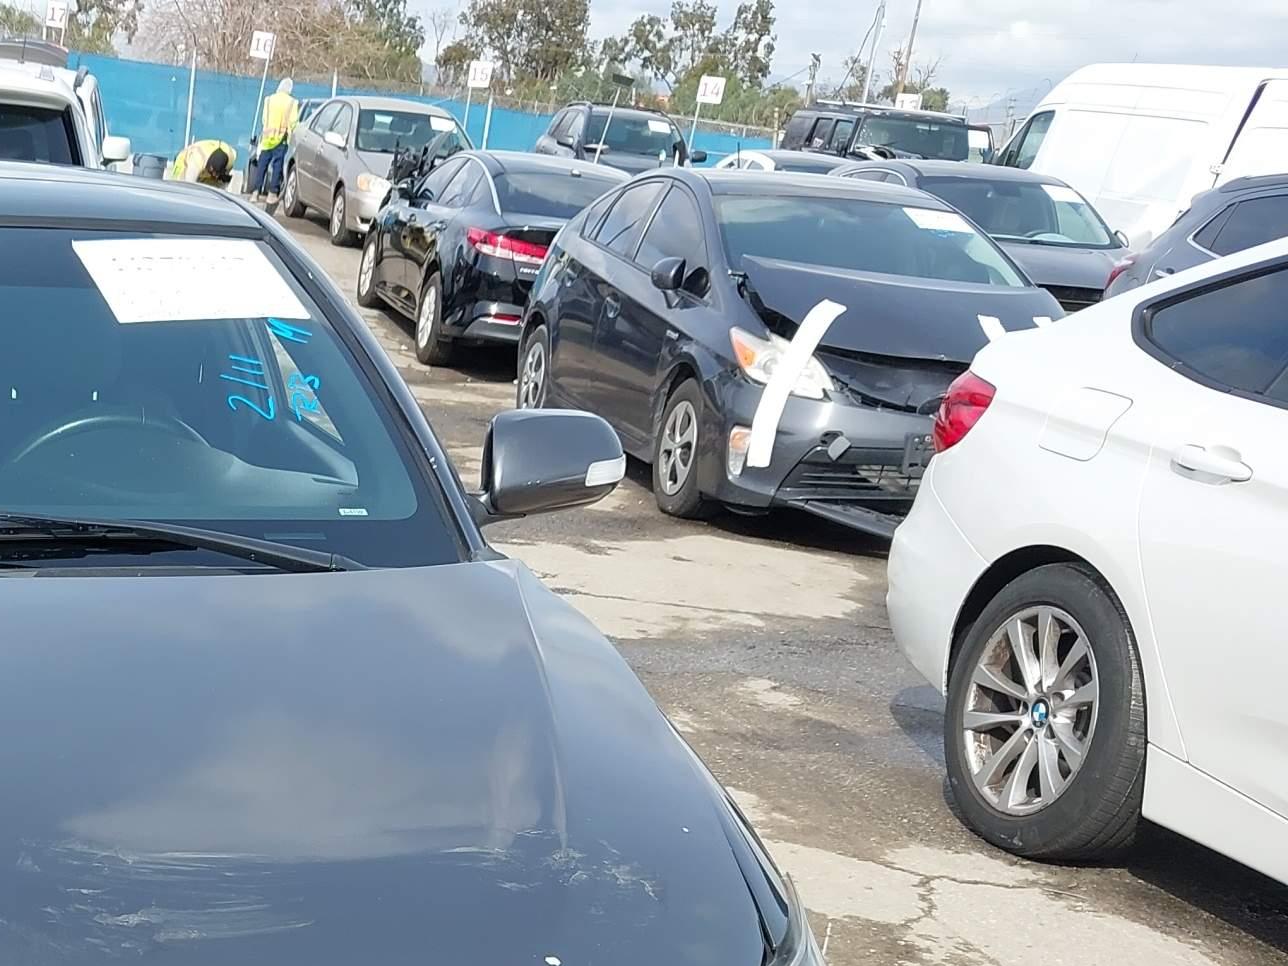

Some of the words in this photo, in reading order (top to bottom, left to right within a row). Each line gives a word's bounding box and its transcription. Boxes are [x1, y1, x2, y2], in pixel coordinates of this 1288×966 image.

[47, 7, 67, 23] 17
[471, 66, 489, 81] 15
[699, 82, 721, 96] 14
